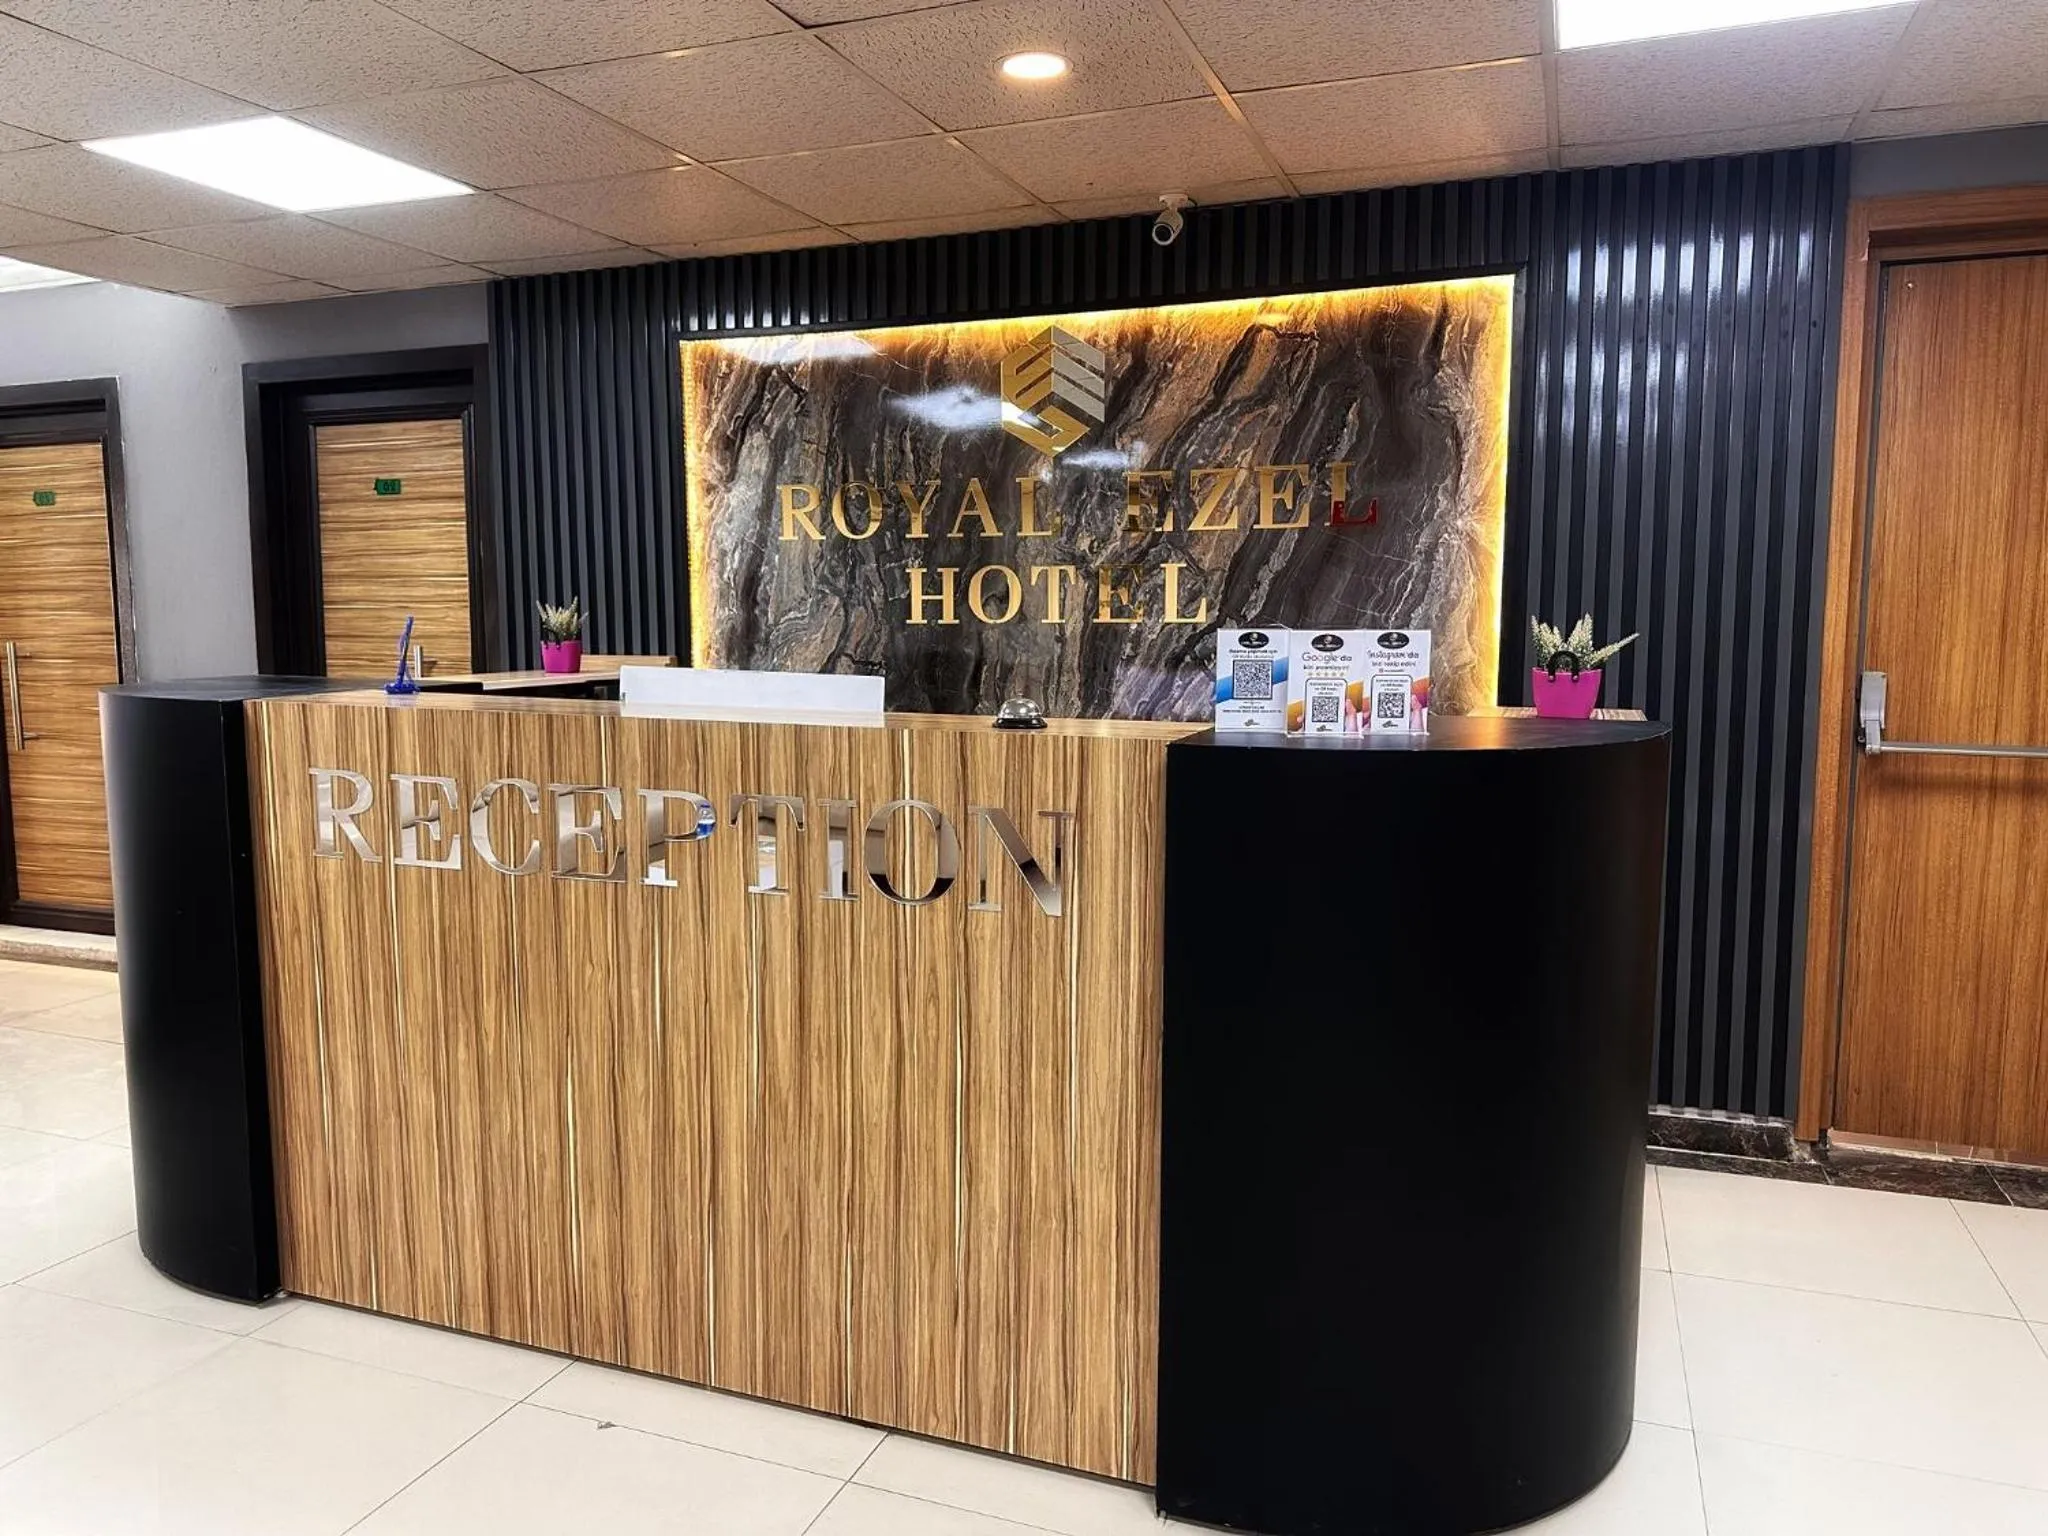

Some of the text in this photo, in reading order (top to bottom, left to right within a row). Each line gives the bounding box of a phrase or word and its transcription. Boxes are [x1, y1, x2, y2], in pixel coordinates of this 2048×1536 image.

[777, 460, 1379, 541] ROYAL EZEL
[905, 562, 1208, 625] HOTEL
[308, 767, 1078, 918] RECEPTION
